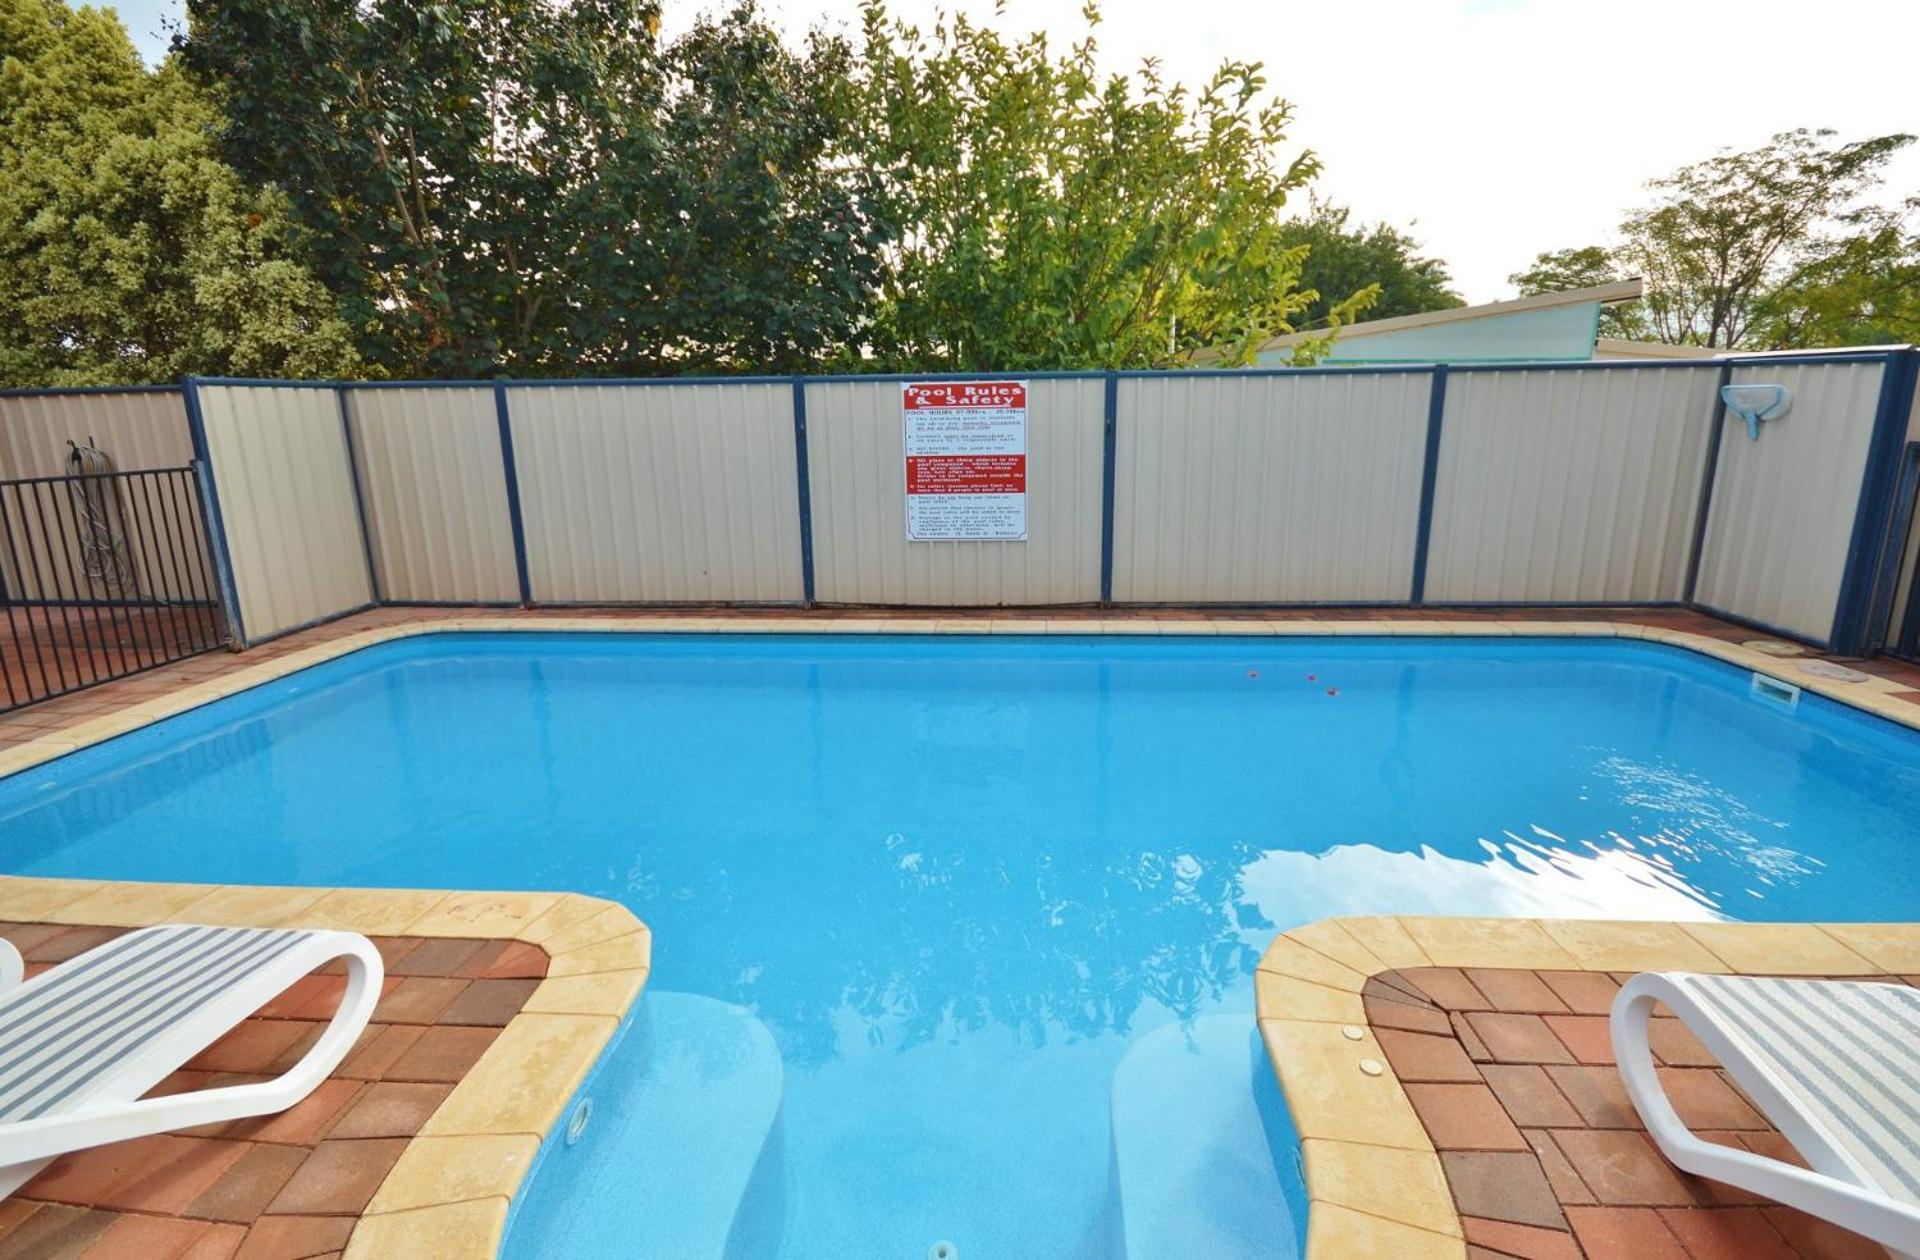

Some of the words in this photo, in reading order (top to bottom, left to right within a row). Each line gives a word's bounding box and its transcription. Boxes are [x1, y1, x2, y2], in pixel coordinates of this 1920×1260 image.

[908, 386, 952, 397] Pool
[965, 386, 1022, 396] Rules
[915, 396, 932, 405] &
[945, 395, 1014, 406] Safety
